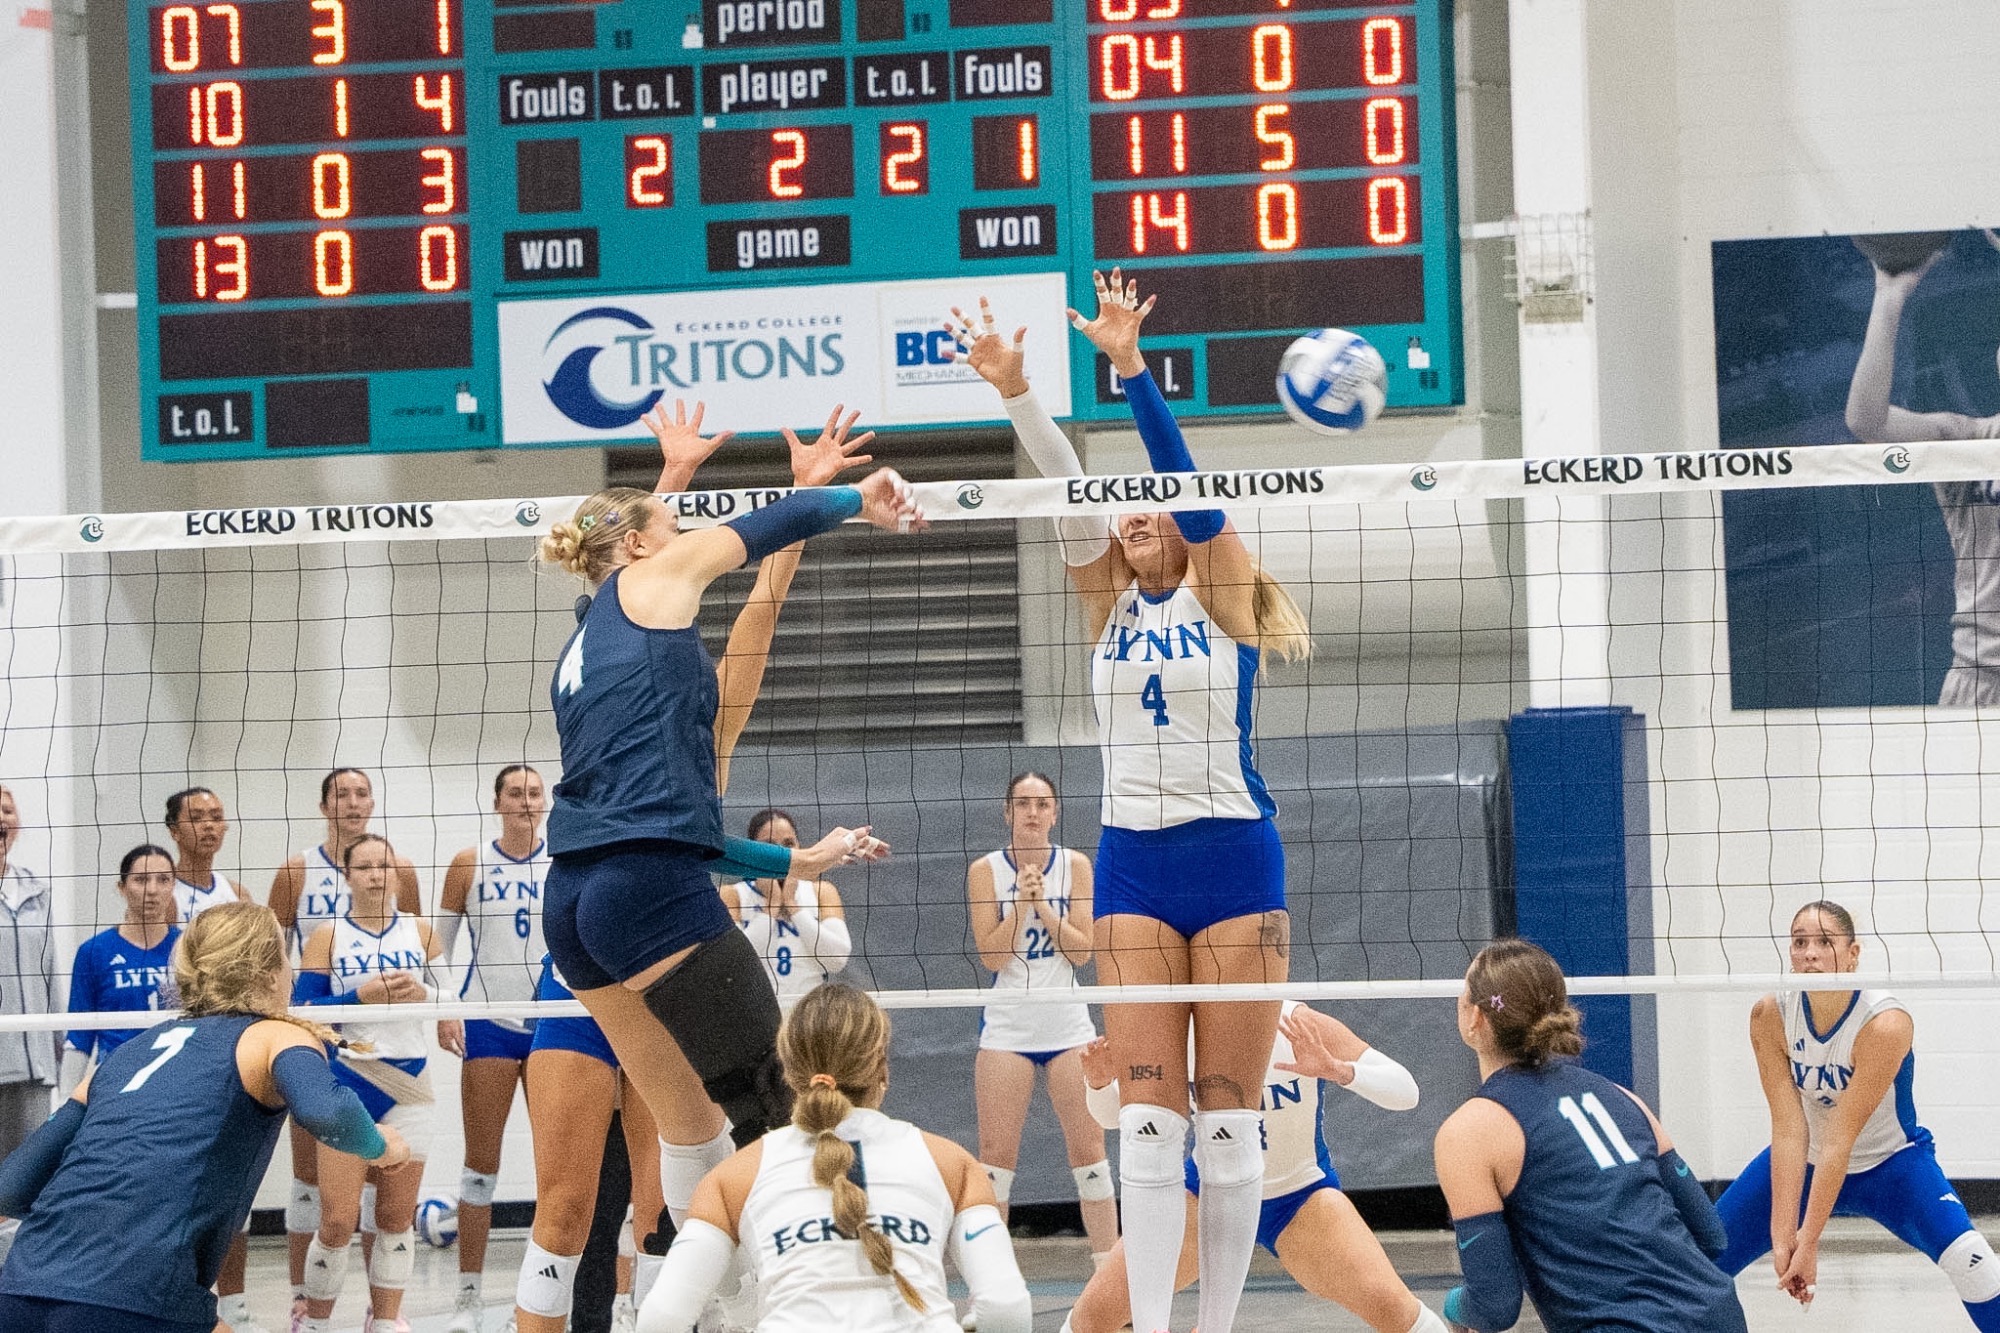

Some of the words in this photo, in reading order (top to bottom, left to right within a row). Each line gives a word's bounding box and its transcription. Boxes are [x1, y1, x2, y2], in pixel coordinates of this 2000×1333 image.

[162, 4, 240, 72] 07
[311, 0, 345, 65] 3
[718, 0, 825, 43] period
[1363, 17, 1402, 86] 0
[720, 63, 827, 113] player
[965, 54, 1043, 94] fouls
[1101, 33, 1184, 100] 04
[1252, 24, 1293, 93] 0
[190, 80, 243, 147] 10
[335, 79, 348, 138] 1
[415, 75, 452, 132] 4
[509, 79, 585, 118] fouls
[885, 125, 922, 190] 2
[1019, 121, 1034, 181] 1
[1130, 113, 1186, 174] 11
[1255, 104, 1295, 171] 5
[1365, 97, 1404, 165] 0
[192, 161, 246, 221] 11
[312, 153, 350, 219] 0
[420, 147, 454, 214] 3
[631, 138, 667, 204] 2
[768, 129, 806, 197] 2
[976, 214, 1041, 248] won
[1132, 192, 1188, 254] 14
[1257, 183, 1298, 251] 0
[1368, 177, 1407, 244] 0
[195, 235, 248, 300] 13
[314, 230, 352, 296] 0
[419, 225, 457, 290] 0
[520, 236, 584, 270] won
[737, 226, 820, 268] game
[676, 320, 750, 333] ECKERD
[757, 315, 844, 329] COLLEGE
[615, 333, 845, 389] TRITONS
[1067, 473, 1181, 504] ECKERD
[1191, 469, 1325, 499] TRITONS
[1523, 456, 1643, 485] ECKERD
[1654, 449, 1792, 480] TRITONS
[186, 507, 295, 535] ECKERD
[306, 503, 434, 532] TRITONS
[1103, 620, 1211, 662] LYNN
[1141, 674, 1169, 726] 4
[515, 908, 530, 938] 6
[1026, 928, 1055, 960] 22
[339, 950, 424, 977] LYNN
[777, 946, 791, 976] 8
[119, 1026, 197, 1094] 7
[1129, 1065, 1164, 1081] 1954
[1791, 1060, 1855, 1091] YNN
[1557, 1091, 1639, 1170] 11
[773, 1214, 932, 1256] ECKRD
